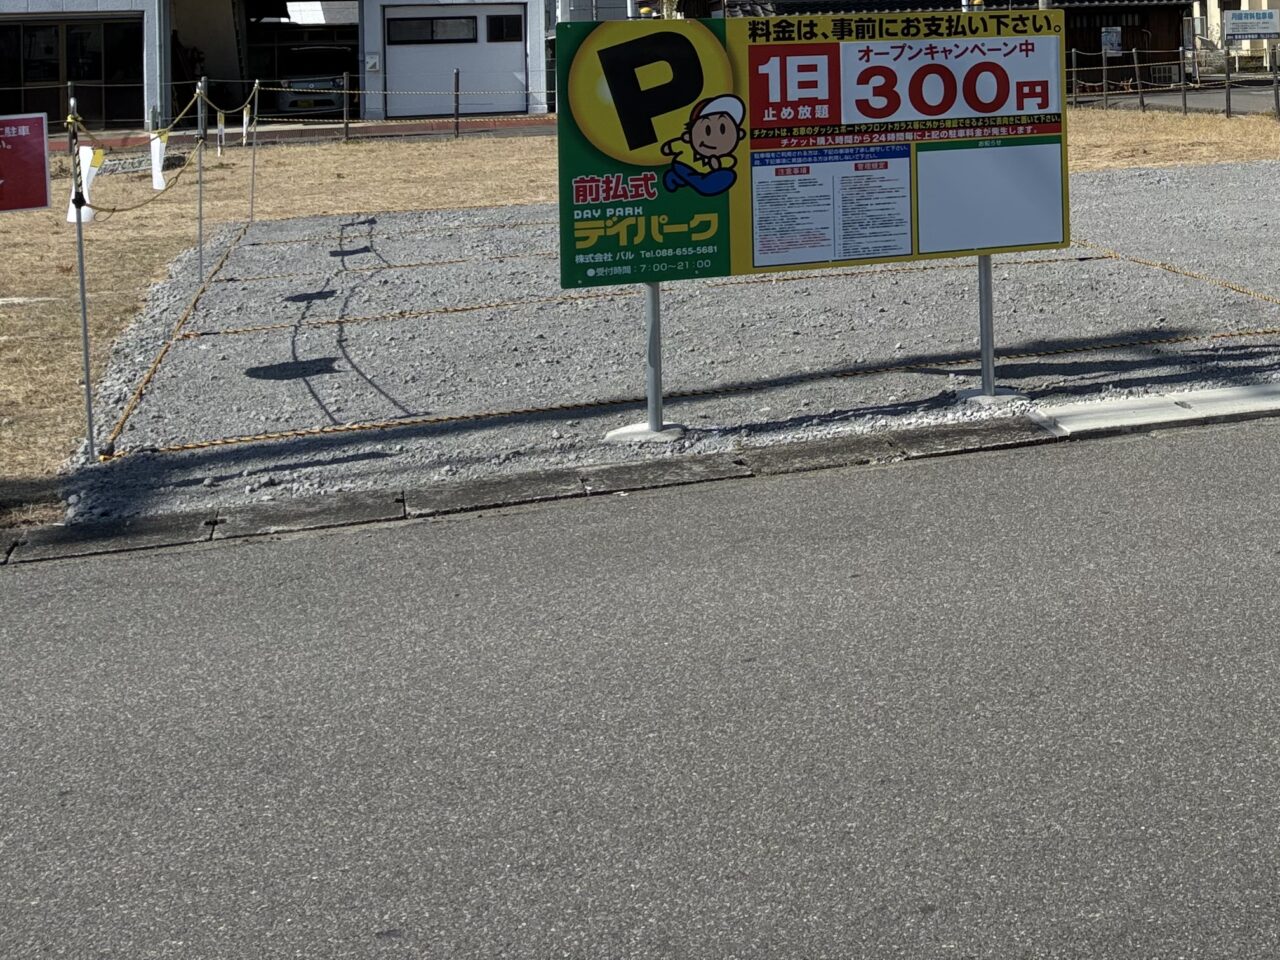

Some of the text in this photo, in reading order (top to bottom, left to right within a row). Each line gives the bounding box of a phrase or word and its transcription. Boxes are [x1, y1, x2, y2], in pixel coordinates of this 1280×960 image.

[748, 14, 1061, 42] 料金は、事前にお支払い下さい。
[858, 40, 1035, 63] オープンキャンペーン中
[597, 31, 704, 151] P
[758, 54, 829, 103] 1日
[855, 61, 1049, 119] 300円
[763, 104, 829, 121] 止め放題
[572, 172, 657, 204] 前払式
[574, 206, 643, 219] DAY PARK
[574, 213, 719, 249] デイパーク
[575, 252, 613, 264] 株式会社
